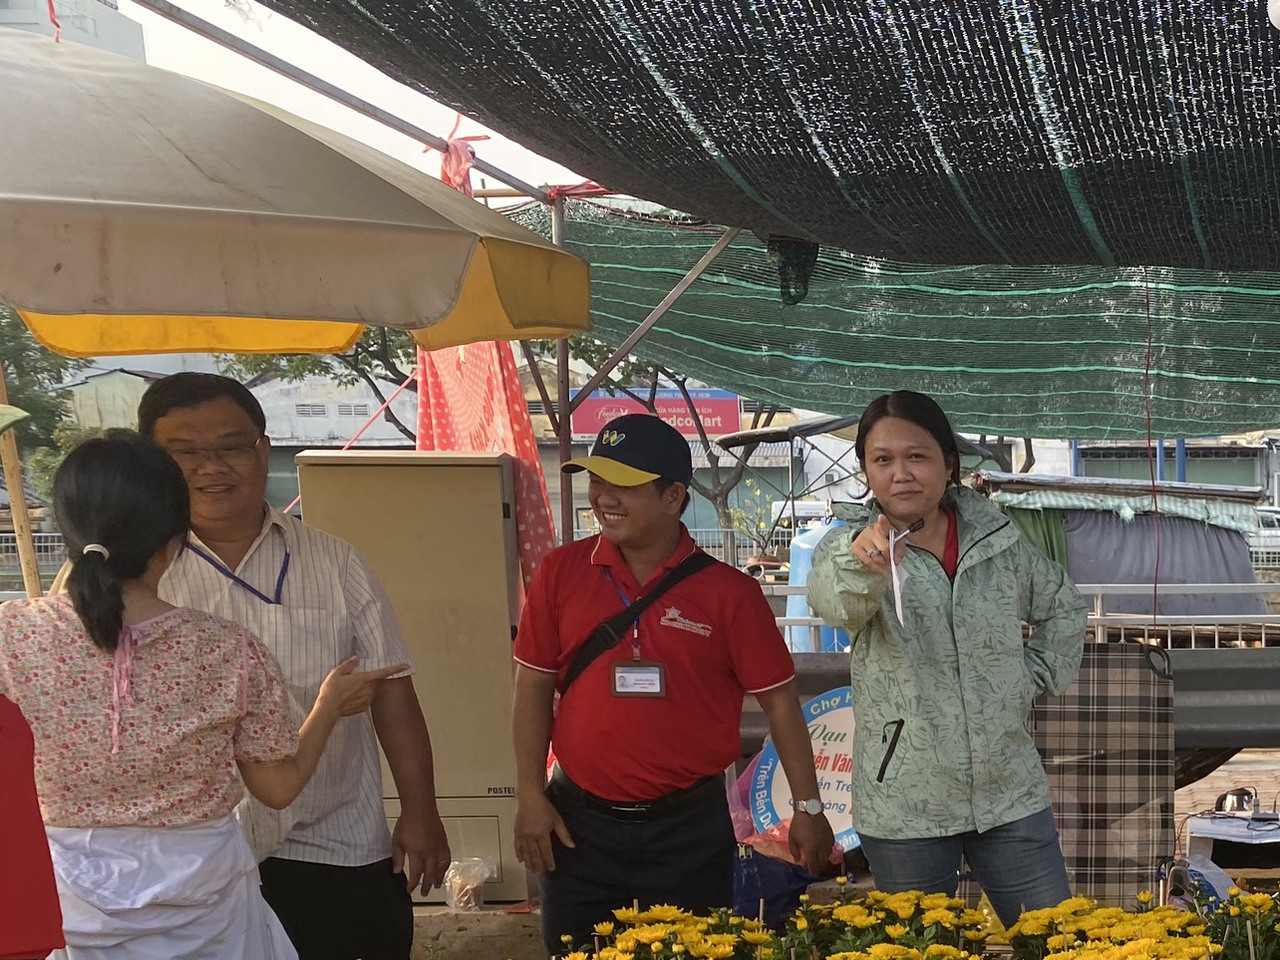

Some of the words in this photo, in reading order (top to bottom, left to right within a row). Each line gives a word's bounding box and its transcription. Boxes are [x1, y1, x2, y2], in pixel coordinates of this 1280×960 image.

[810, 696, 841, 715] Chợ
[831, 753, 853, 773] Văn
[817, 776, 831, 790] ến
[755, 790, 770, 814] Bến
